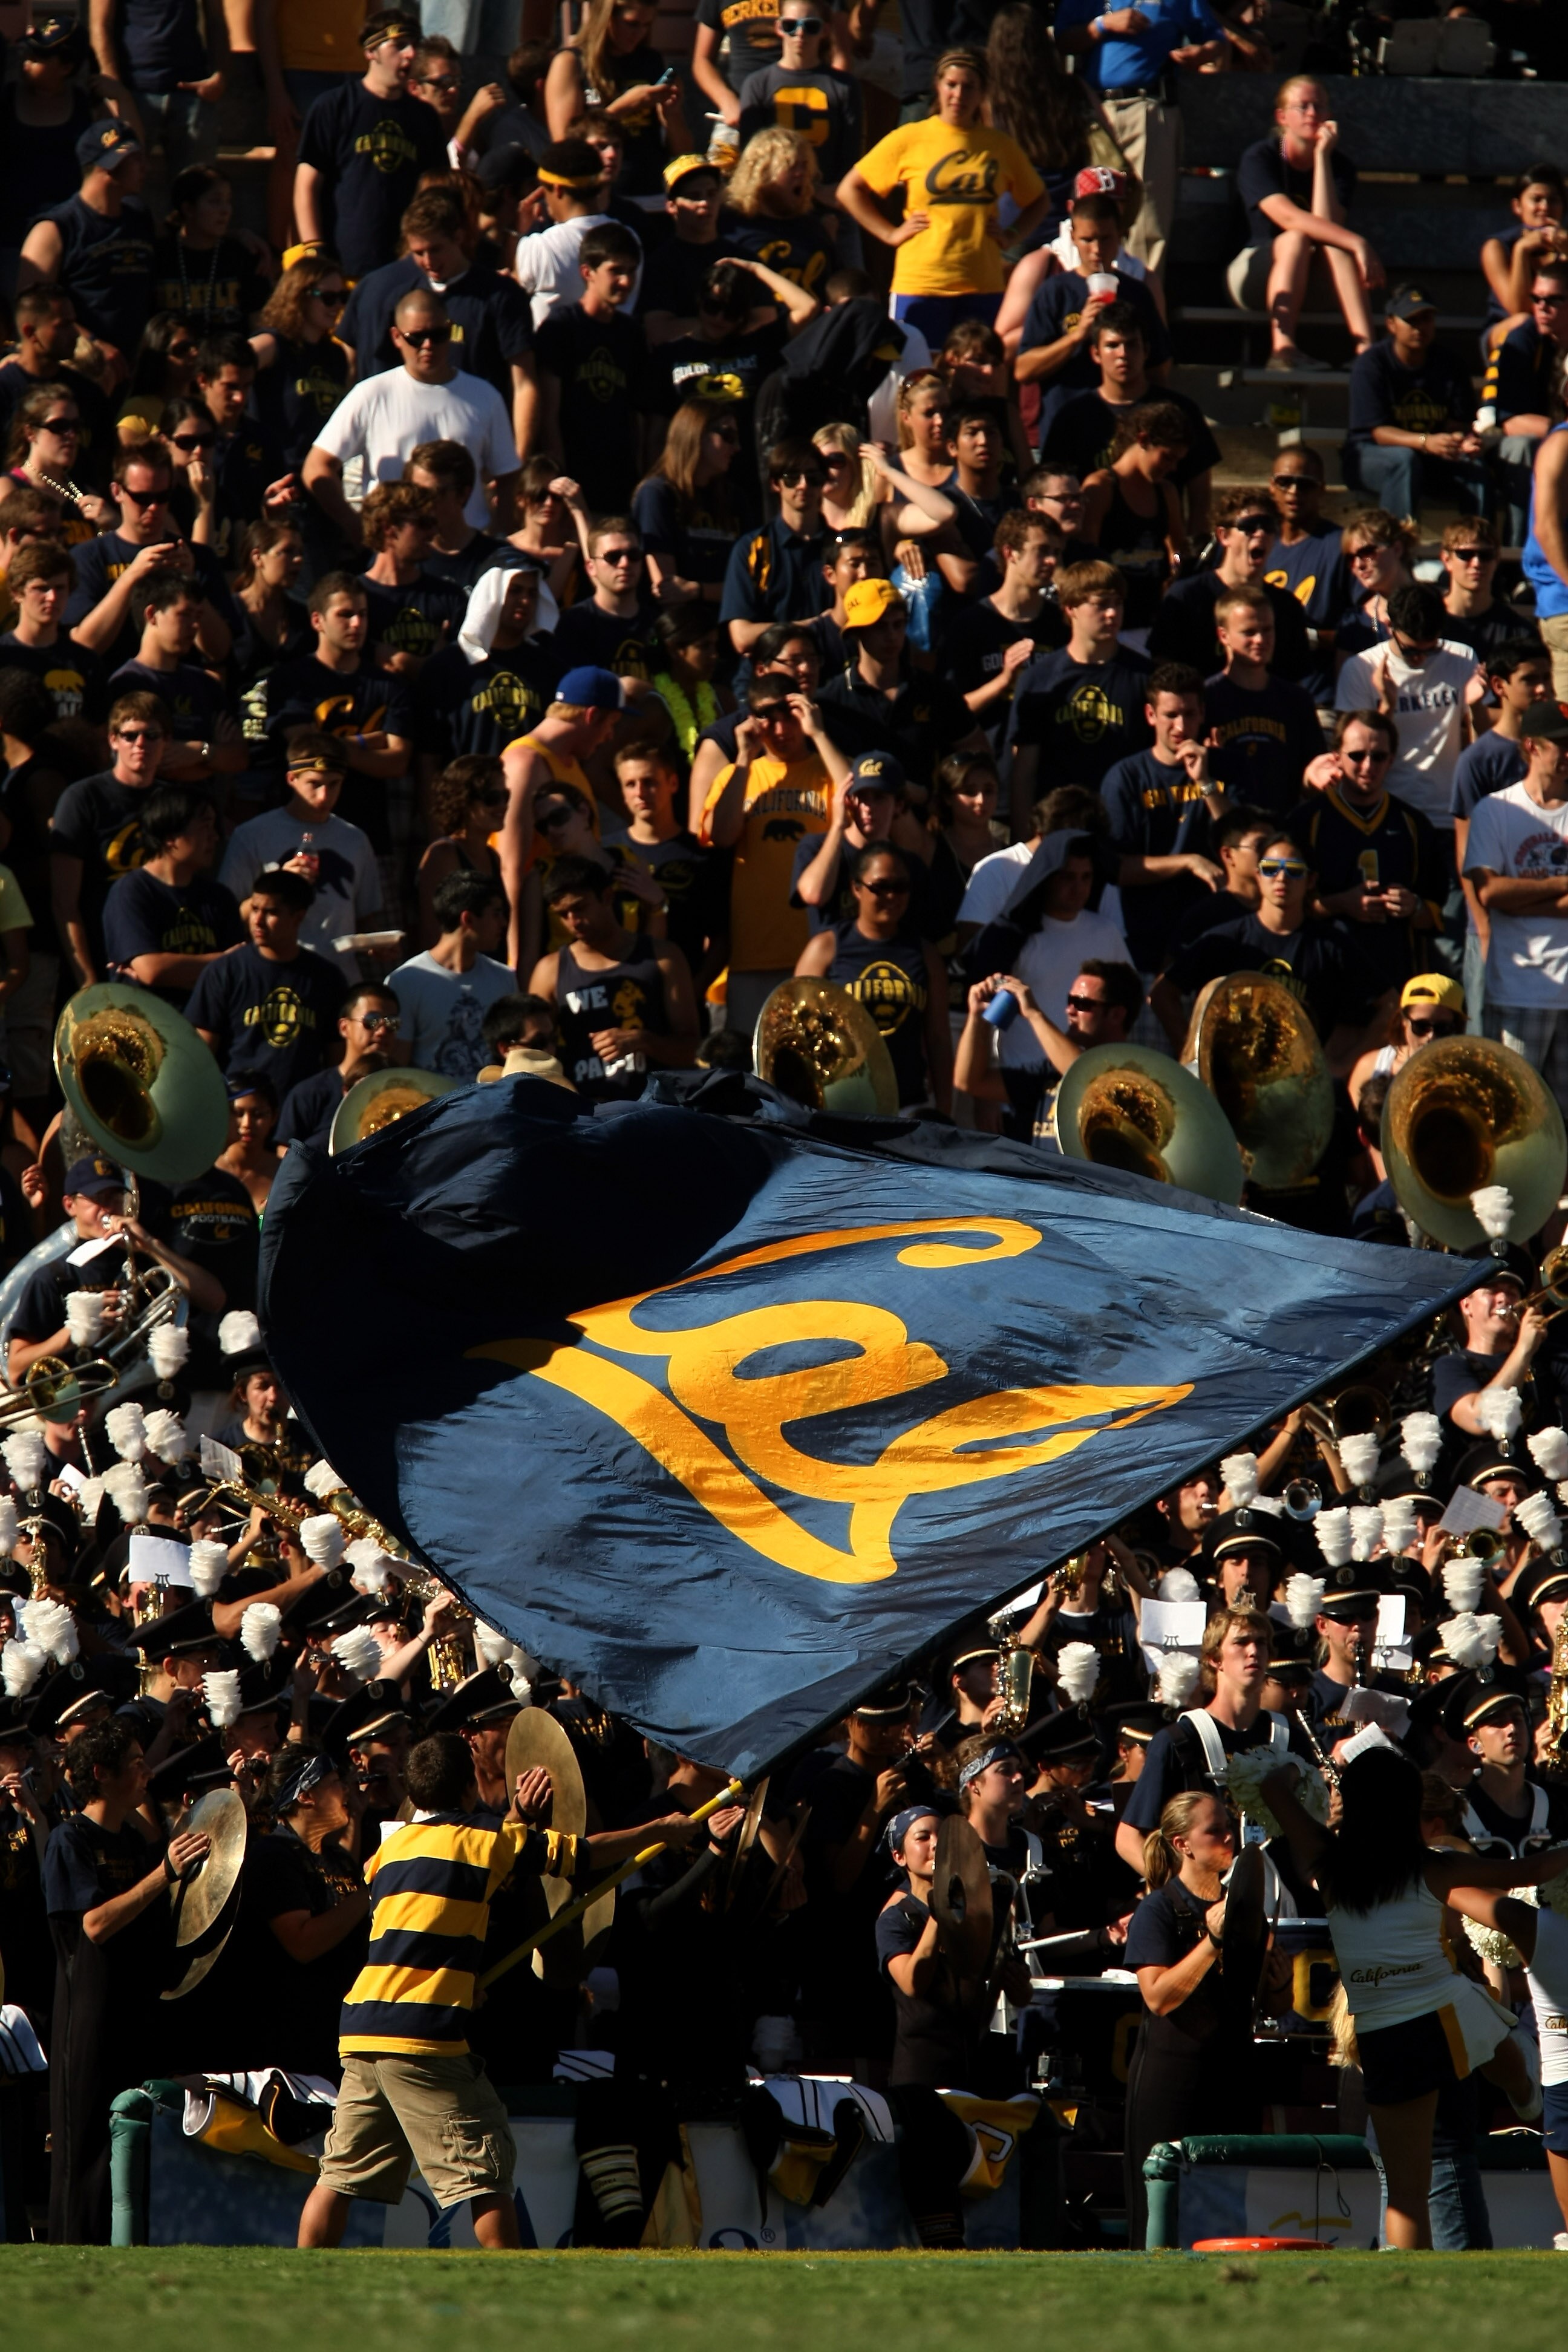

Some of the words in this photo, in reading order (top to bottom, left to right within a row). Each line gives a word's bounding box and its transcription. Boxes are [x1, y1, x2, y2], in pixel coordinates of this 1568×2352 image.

[926, 150, 998, 201] Cal
[472, 687, 541, 714] CALIFORNIA
[1055, 699, 1124, 727] CALIFORNIA
[1219, 716, 1287, 748] CALIFORNIA
[859, 759, 883, 778] Cal
[745, 788, 827, 821] CALIFORNIA
[1357, 848, 1379, 881] 1
[162, 924, 217, 949] CALIFORNIA
[565, 985, 608, 1015] WE
[243, 1002, 316, 1030] CALIFORNIA
[170, 1201, 253, 1220] CALIFORNIA
[190, 1214, 250, 1226] FOOTBALL
[463, 1215, 1195, 1584] Cal
[1350, 1963, 1423, 1987] California
